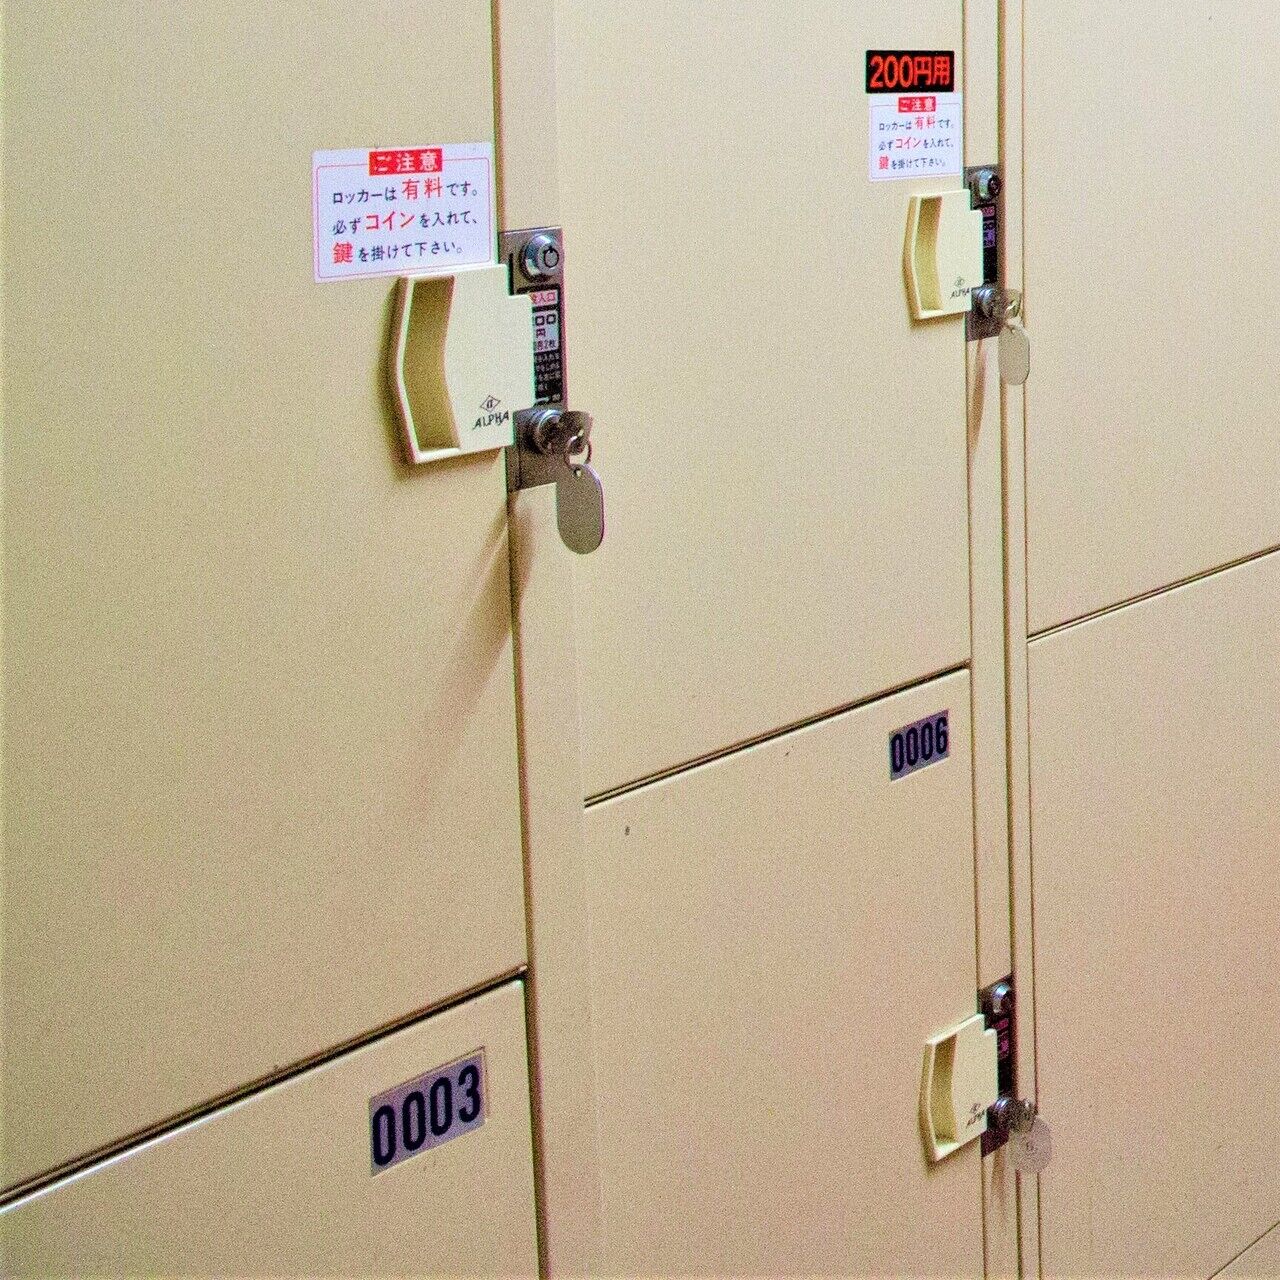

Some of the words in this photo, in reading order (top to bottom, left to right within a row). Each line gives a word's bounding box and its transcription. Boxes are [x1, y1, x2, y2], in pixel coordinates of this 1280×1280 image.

[869, 55, 950, 88] 200円用
[376, 151, 438, 173] ご注意
[332, 210, 478, 236] 必ずコインを入れて、
[332, 241, 463, 265] 鍵を掛けて下さい。
[472, 410, 509, 430] ALPHA
[891, 716, 948, 774] 0006
[372, 1064, 481, 1167] 0003
